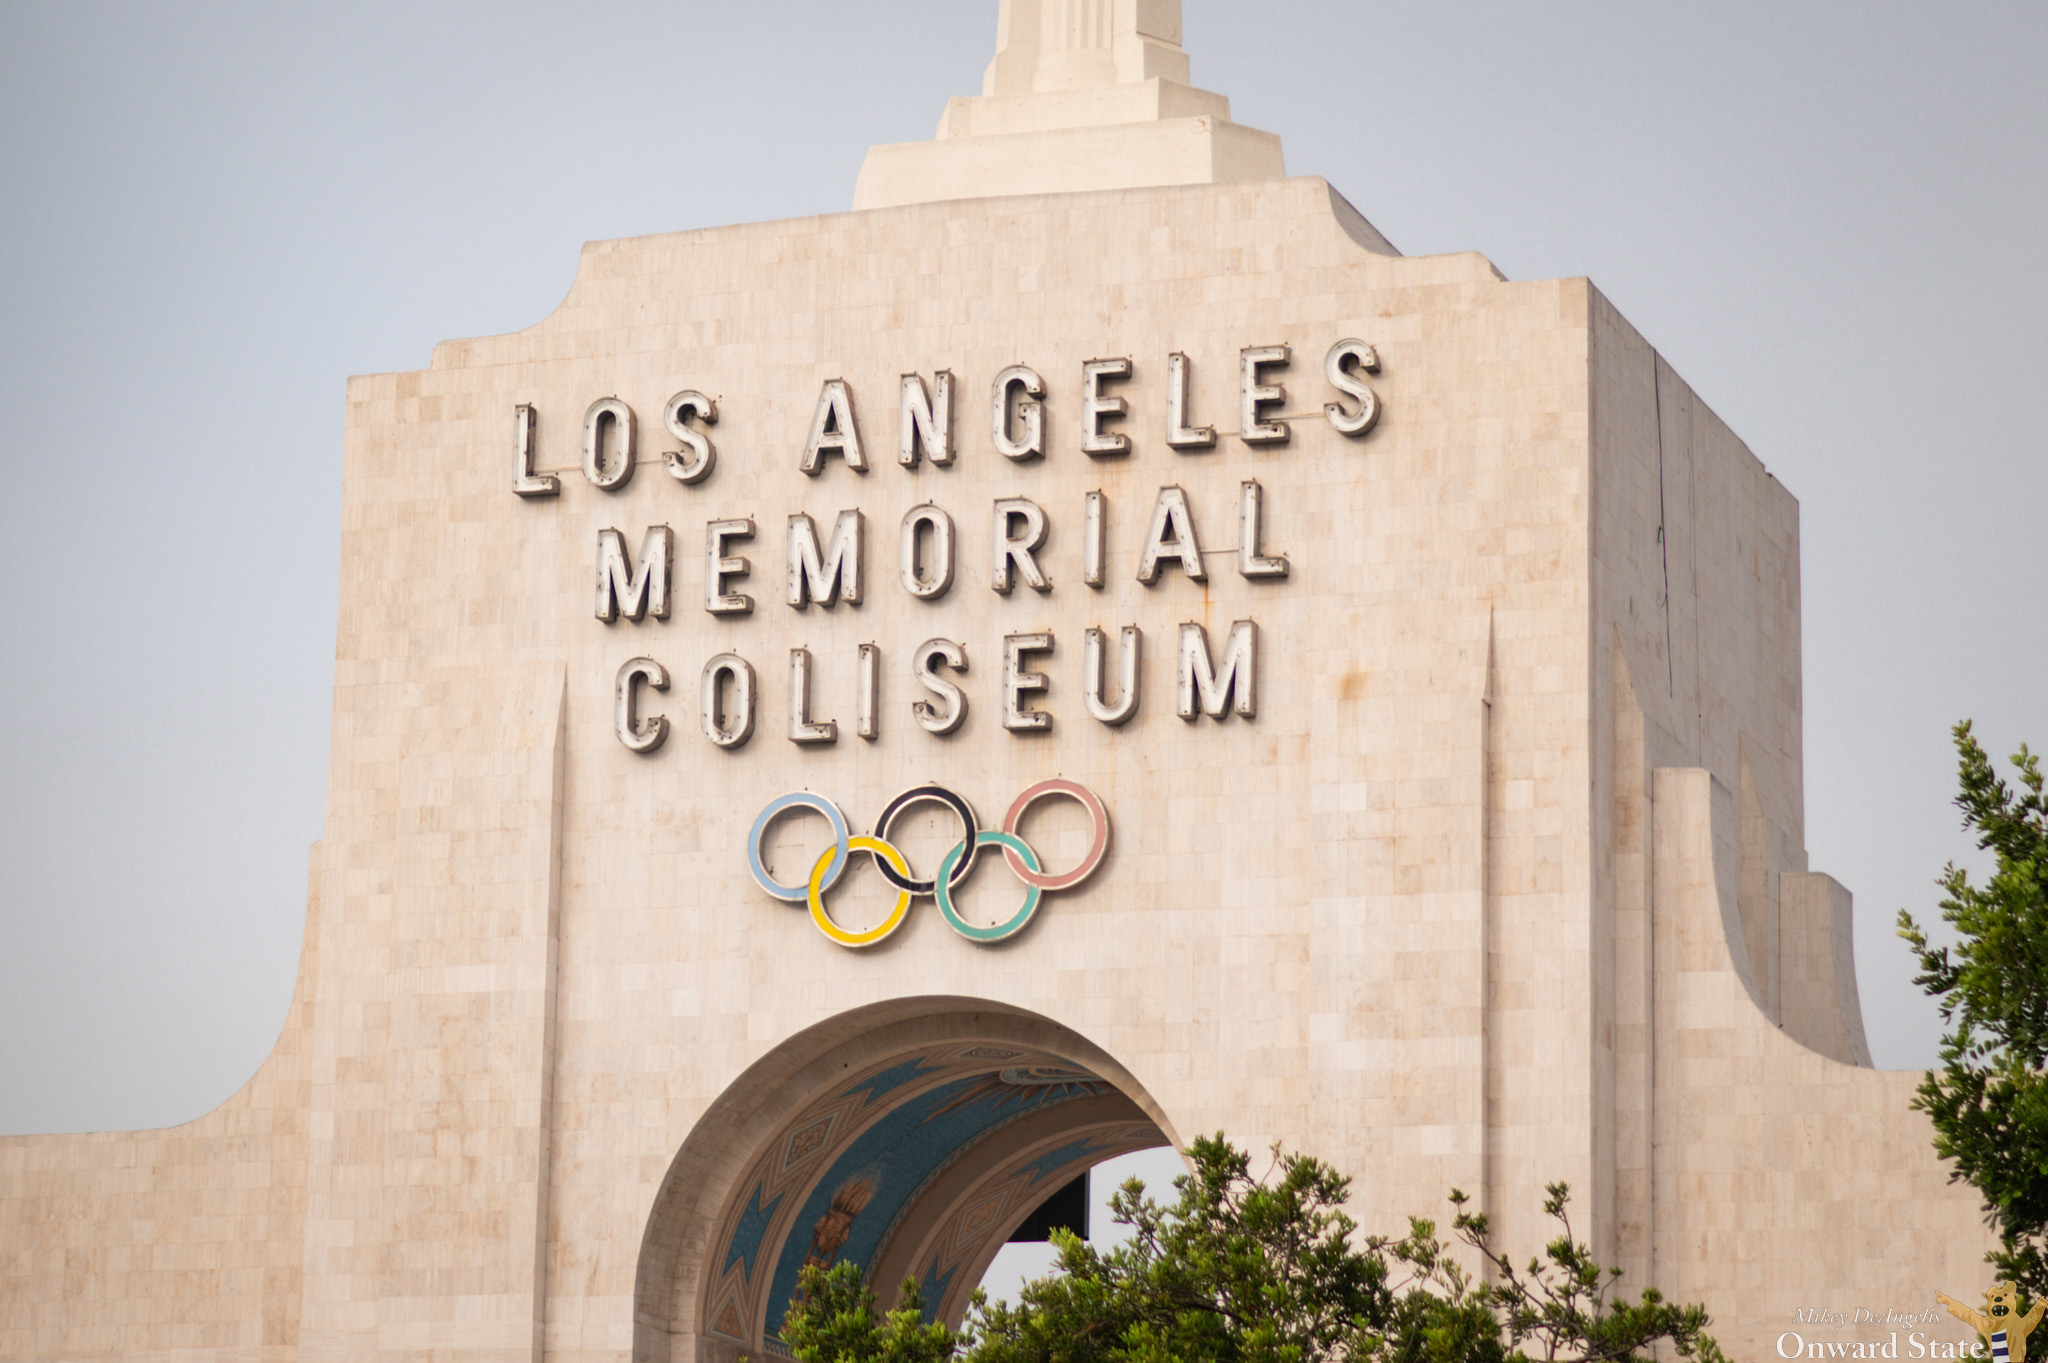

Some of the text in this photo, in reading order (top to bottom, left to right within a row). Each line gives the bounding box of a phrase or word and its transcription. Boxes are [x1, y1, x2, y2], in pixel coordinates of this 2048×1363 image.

[512, 337, 1382, 497] LOS ANGELES
[594, 479, 1290, 623] MEMORIAL
[614, 619, 1259, 754] COLISEUM
